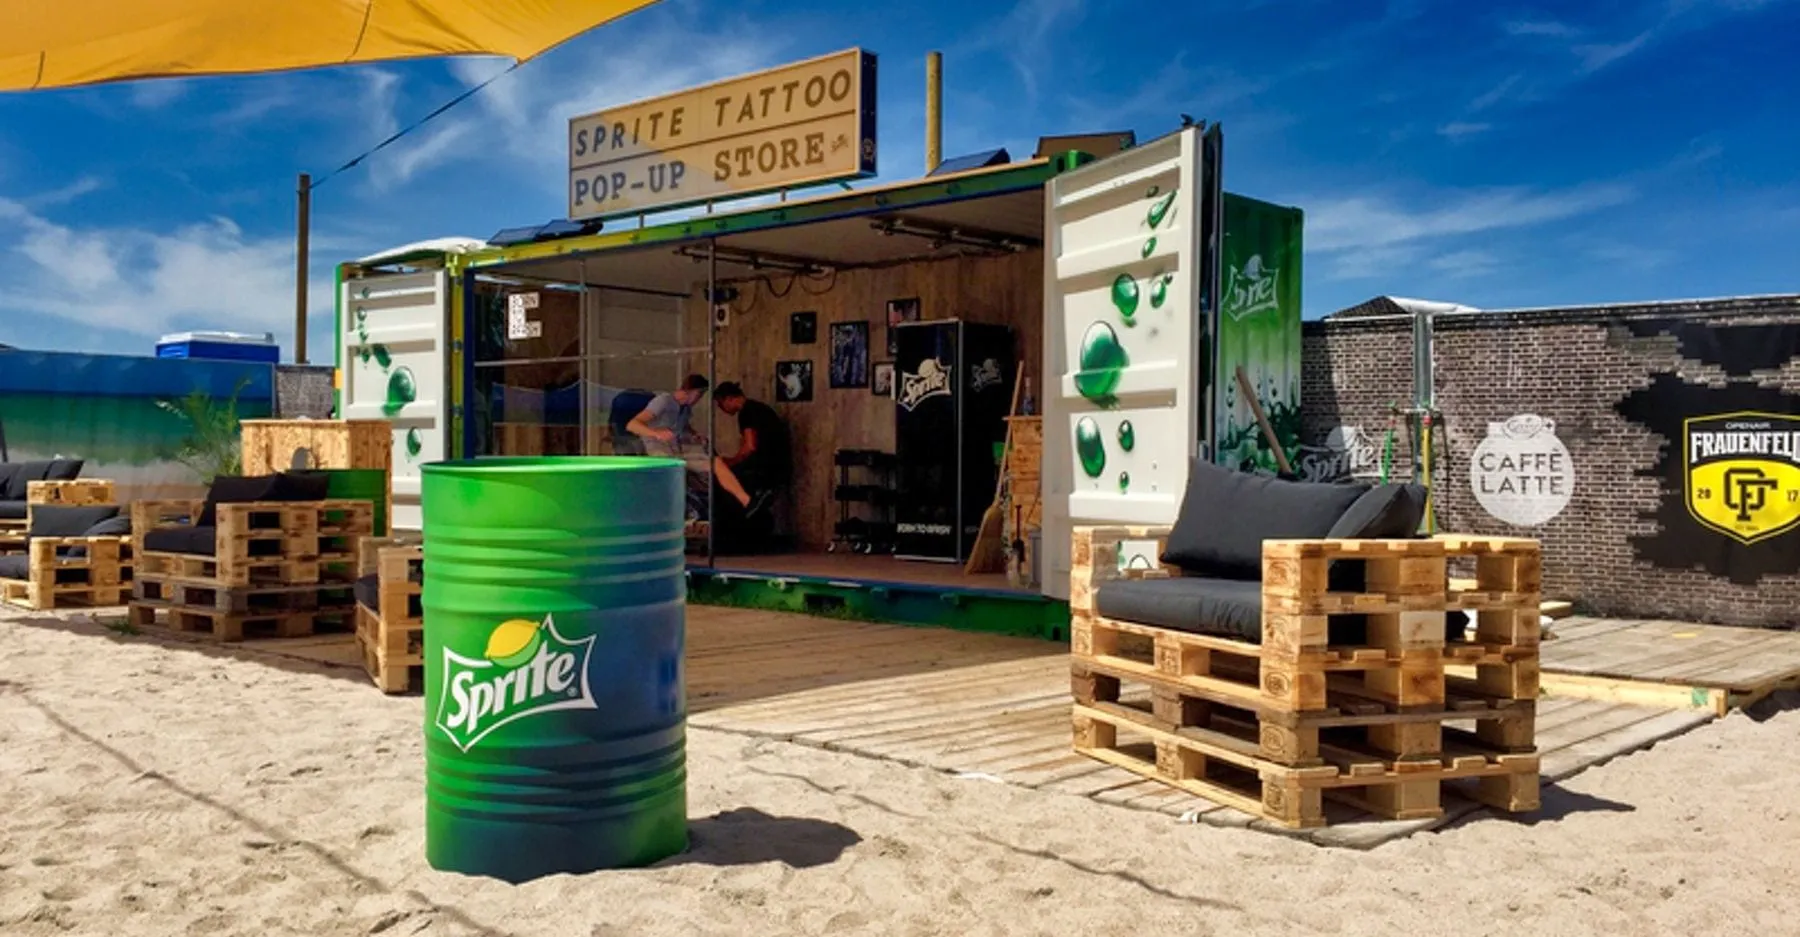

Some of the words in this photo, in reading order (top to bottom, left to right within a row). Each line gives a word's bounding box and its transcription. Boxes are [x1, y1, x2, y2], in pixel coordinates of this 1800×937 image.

[574, 106, 685, 157] SPRITE
[714, 69, 851, 127] TATTOO
[574, 160, 685, 206] POP-UP
[714, 131, 825, 182] STORE
[1302, 437, 1374, 483] Sprite
[1479, 447, 1563, 472] CAFFÈ
[1481, 475, 1565, 495] LATTE
[446, 640, 576, 736] Sprite
